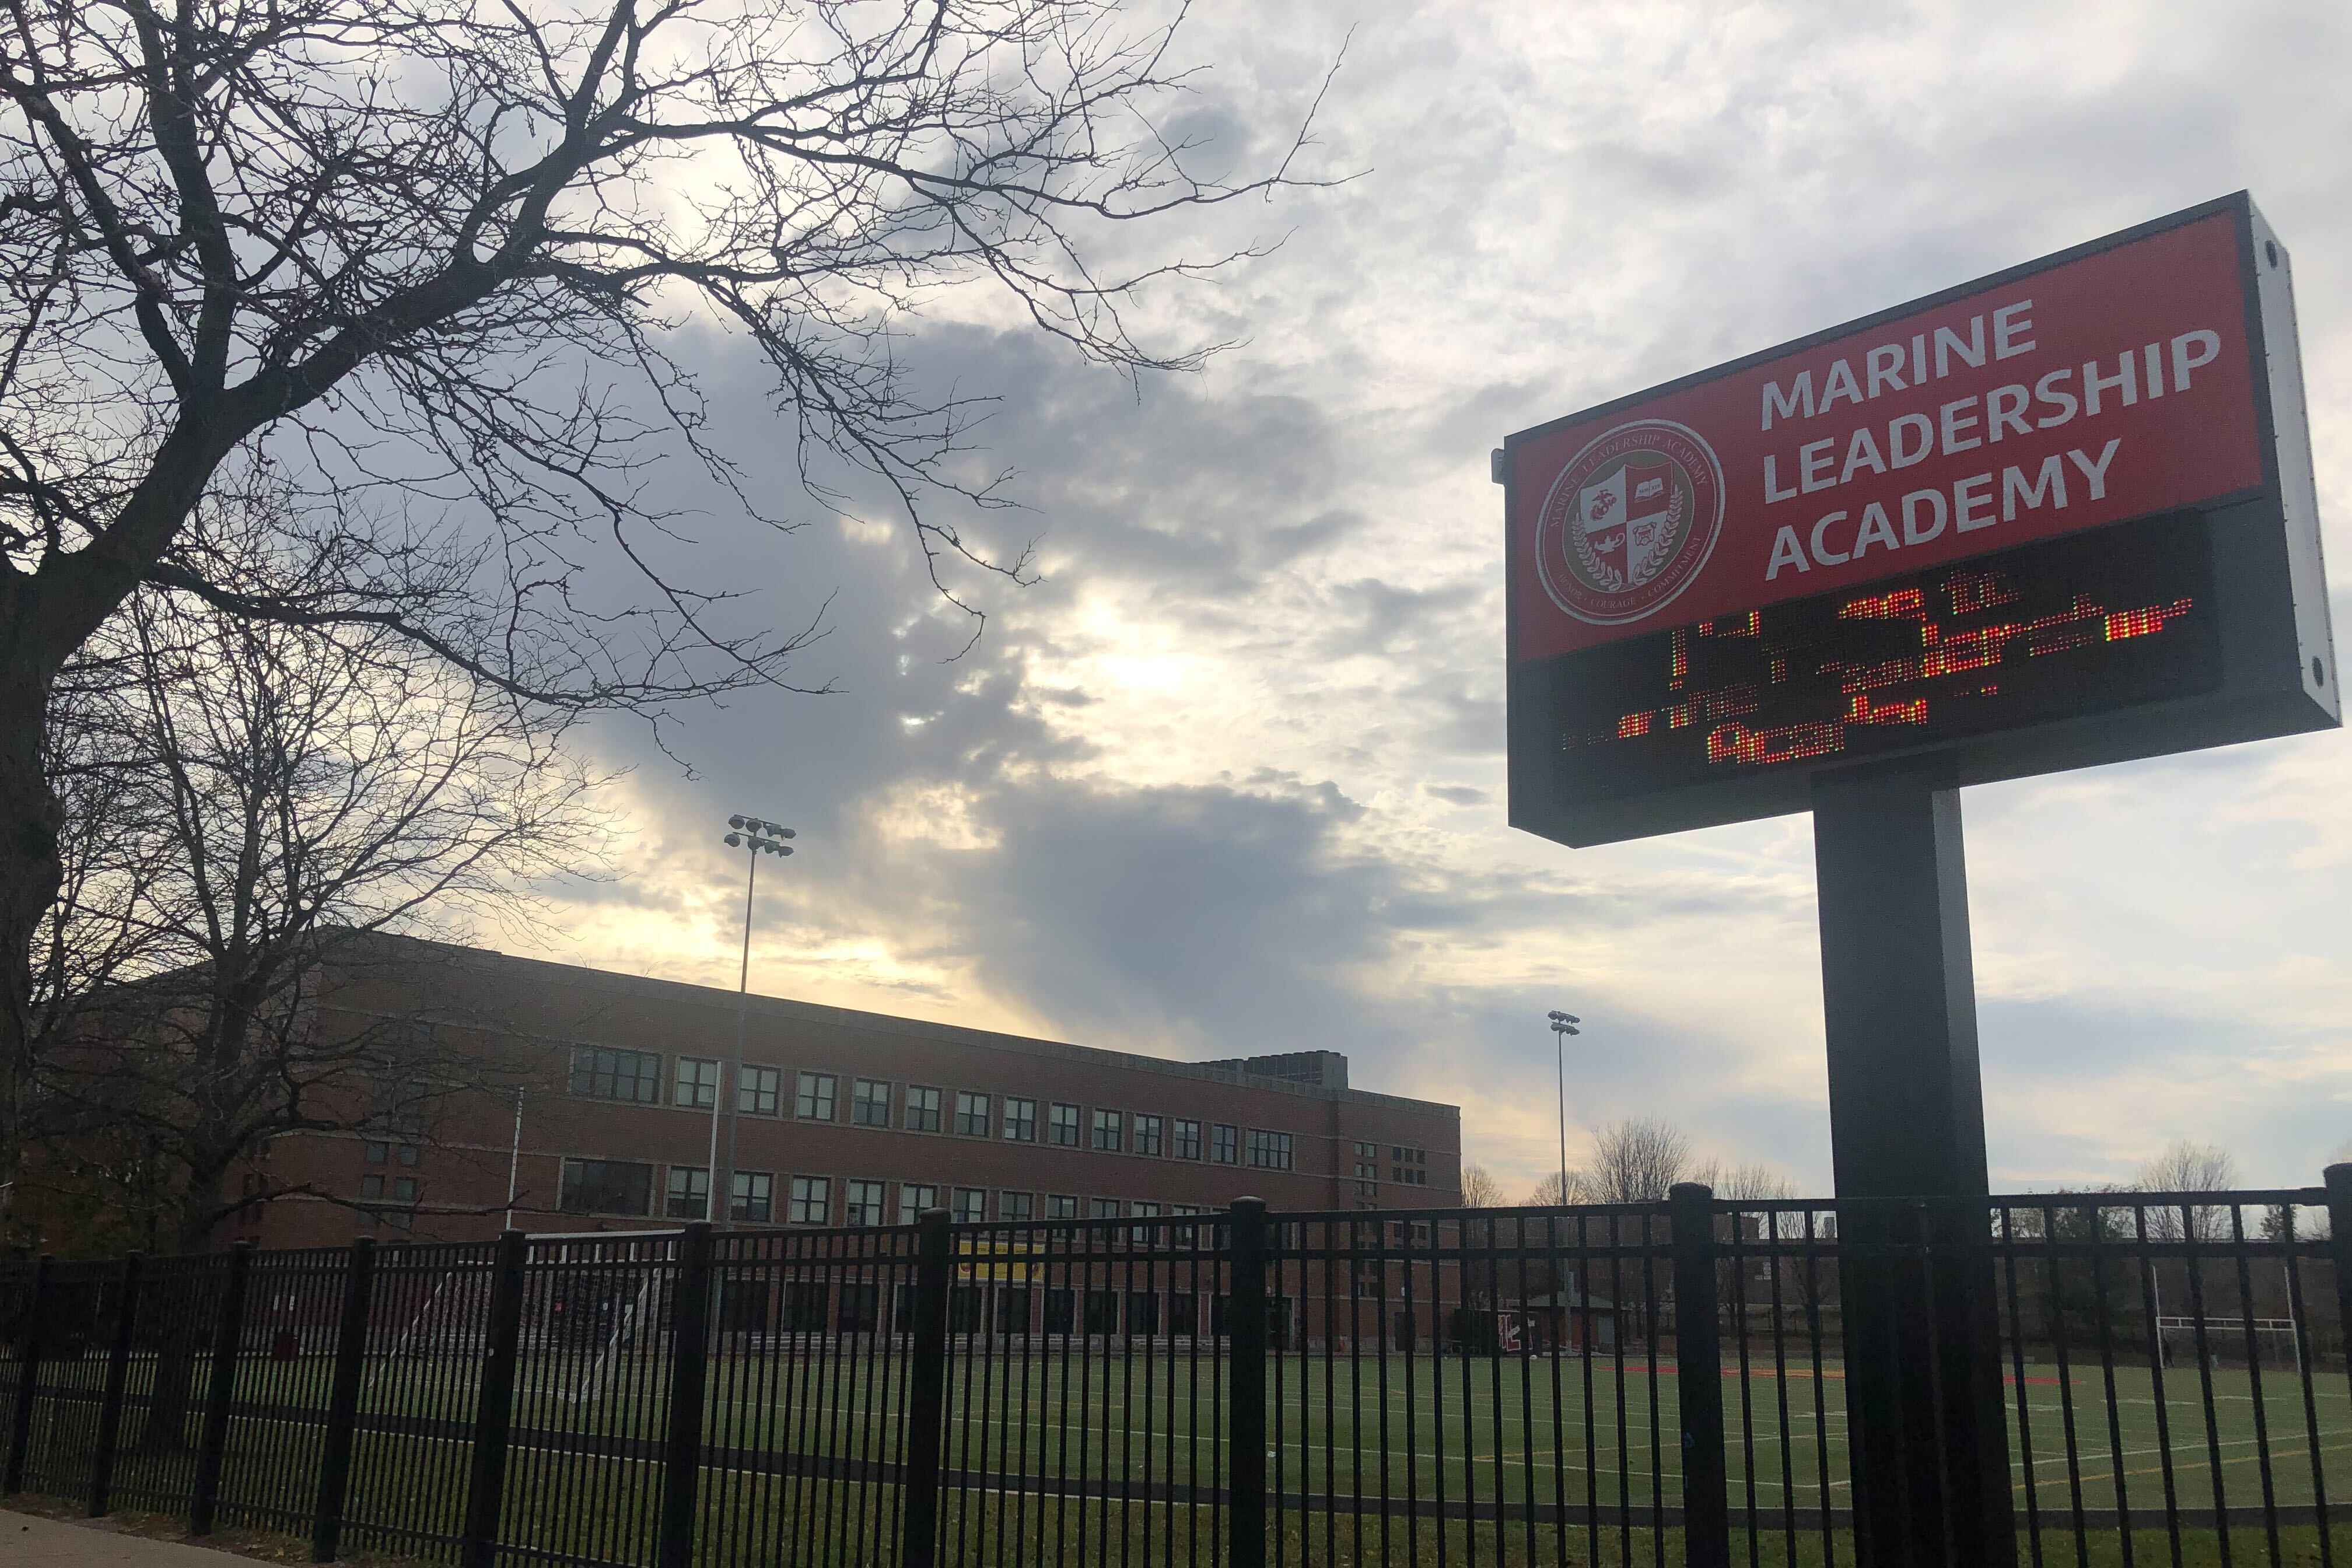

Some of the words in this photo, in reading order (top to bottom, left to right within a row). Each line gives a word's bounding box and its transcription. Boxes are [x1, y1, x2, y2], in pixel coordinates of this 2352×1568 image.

[1761, 299, 2036, 430] MARINE
[1763, 328, 2221, 503] LEADERSHIP
[1581, 435, 1660, 473] LEADERSHIP
[1665, 438, 1707, 486] ACADEMY
[1765, 438, 2121, 581] ACADEMY
[1590, 597, 1636, 609] COURAGE
